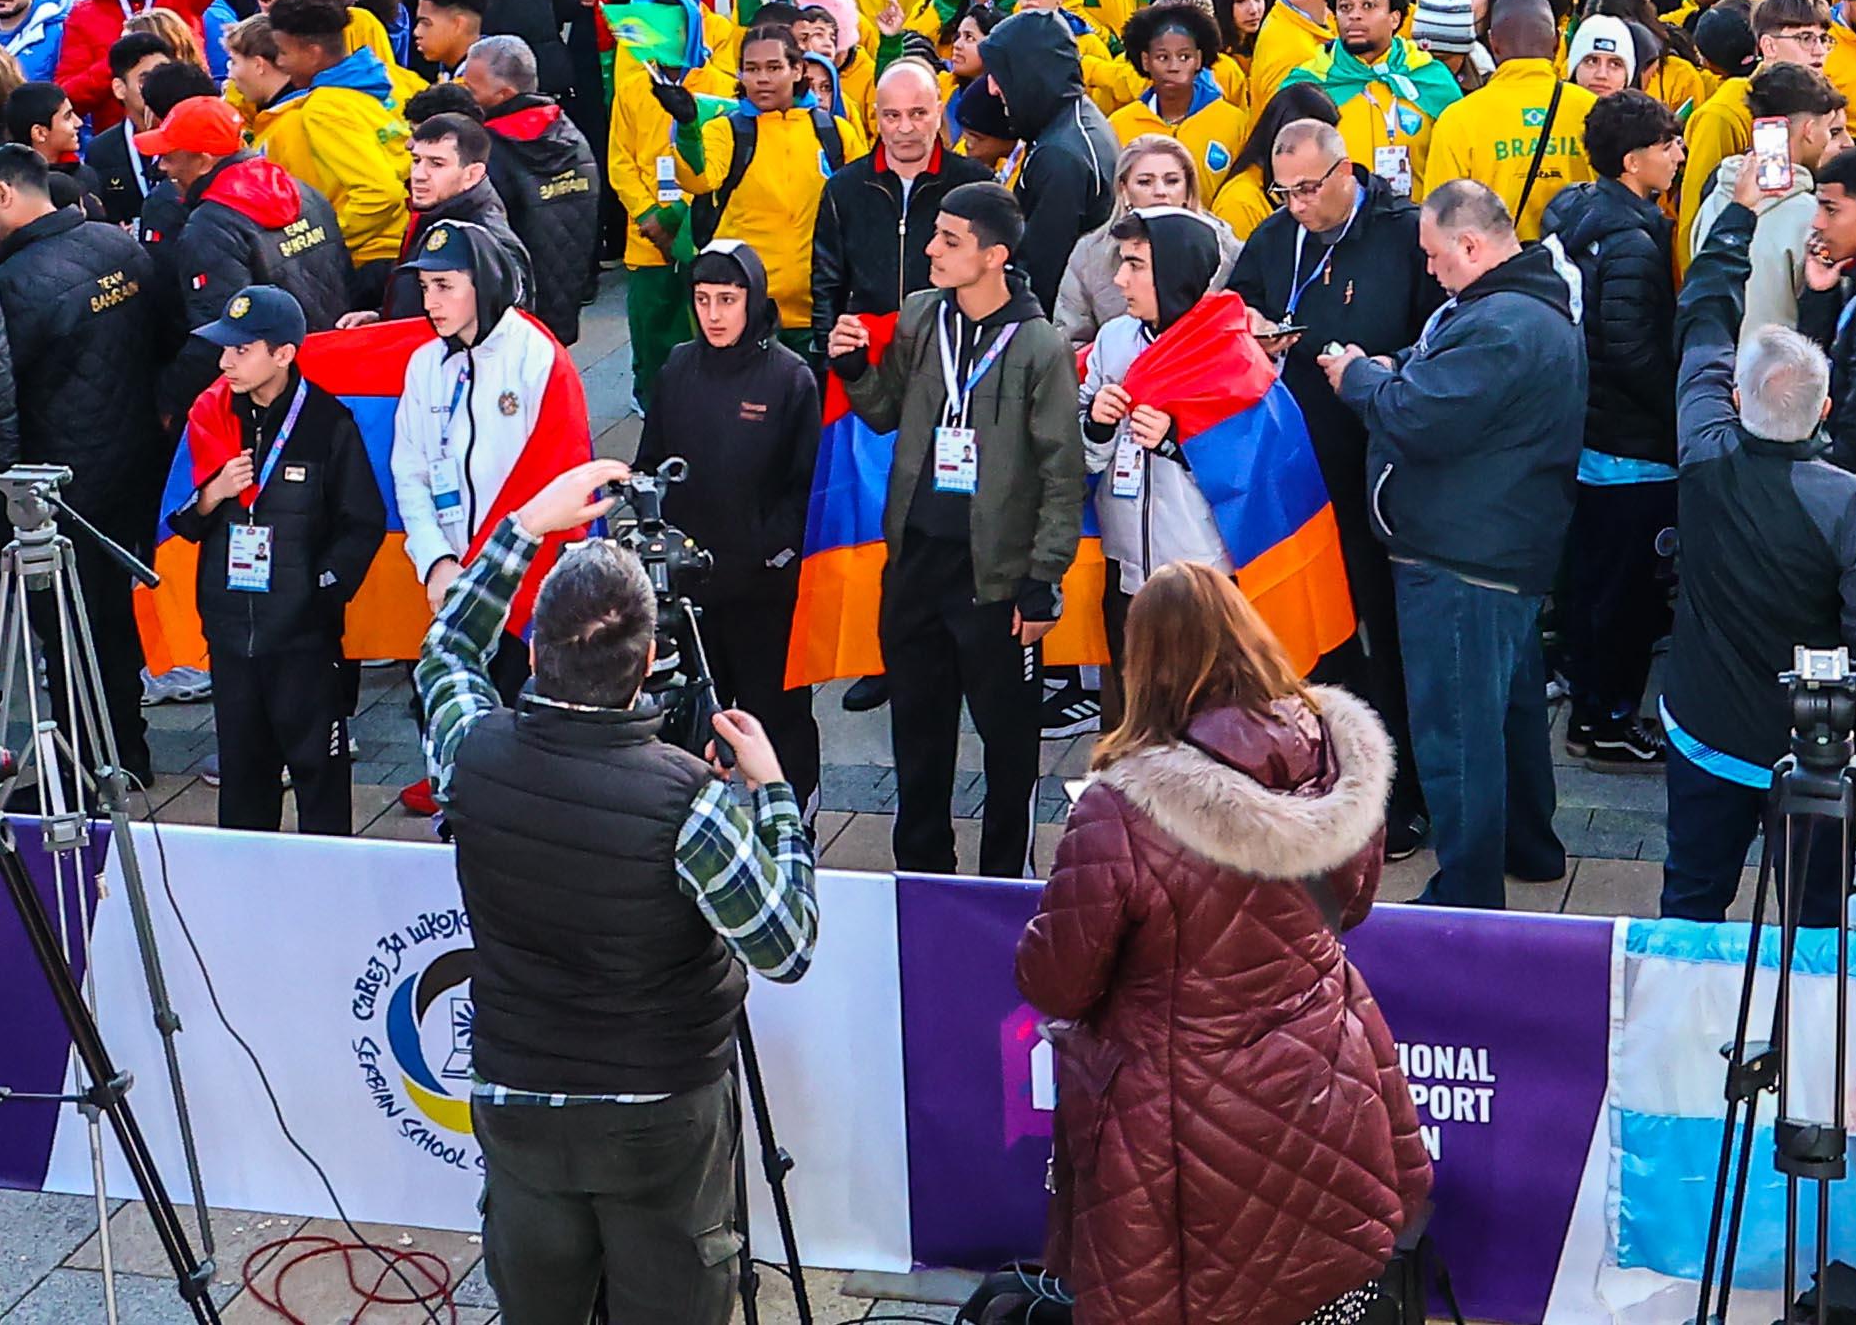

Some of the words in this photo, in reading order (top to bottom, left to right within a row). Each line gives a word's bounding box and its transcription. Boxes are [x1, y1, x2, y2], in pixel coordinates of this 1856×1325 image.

[90, 280, 140, 313] BAHRAIN
[351, 1035, 407, 1119] SERBIAN
[398, 1117, 469, 1170] SCHOOL
[1407, 1083, 1495, 1123] PORT
